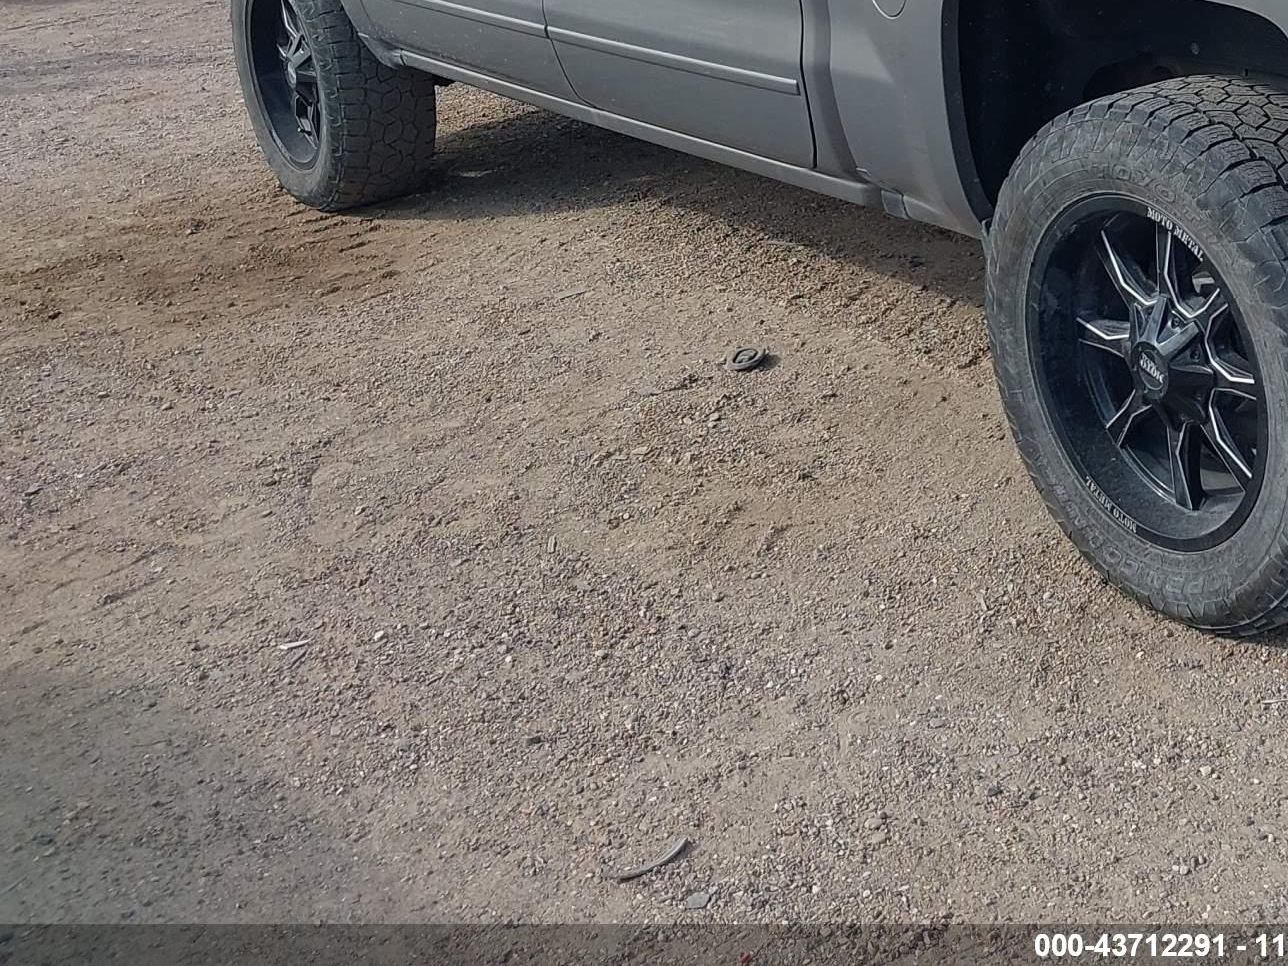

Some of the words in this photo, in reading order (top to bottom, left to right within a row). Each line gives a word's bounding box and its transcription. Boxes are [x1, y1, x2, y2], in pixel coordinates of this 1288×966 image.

[1147, 206, 1173, 230] MOTO
[1173, 225, 1204, 262] METAL
[1086, 475, 1112, 512] METAL
[1113, 508, 1137, 533] MOTO
